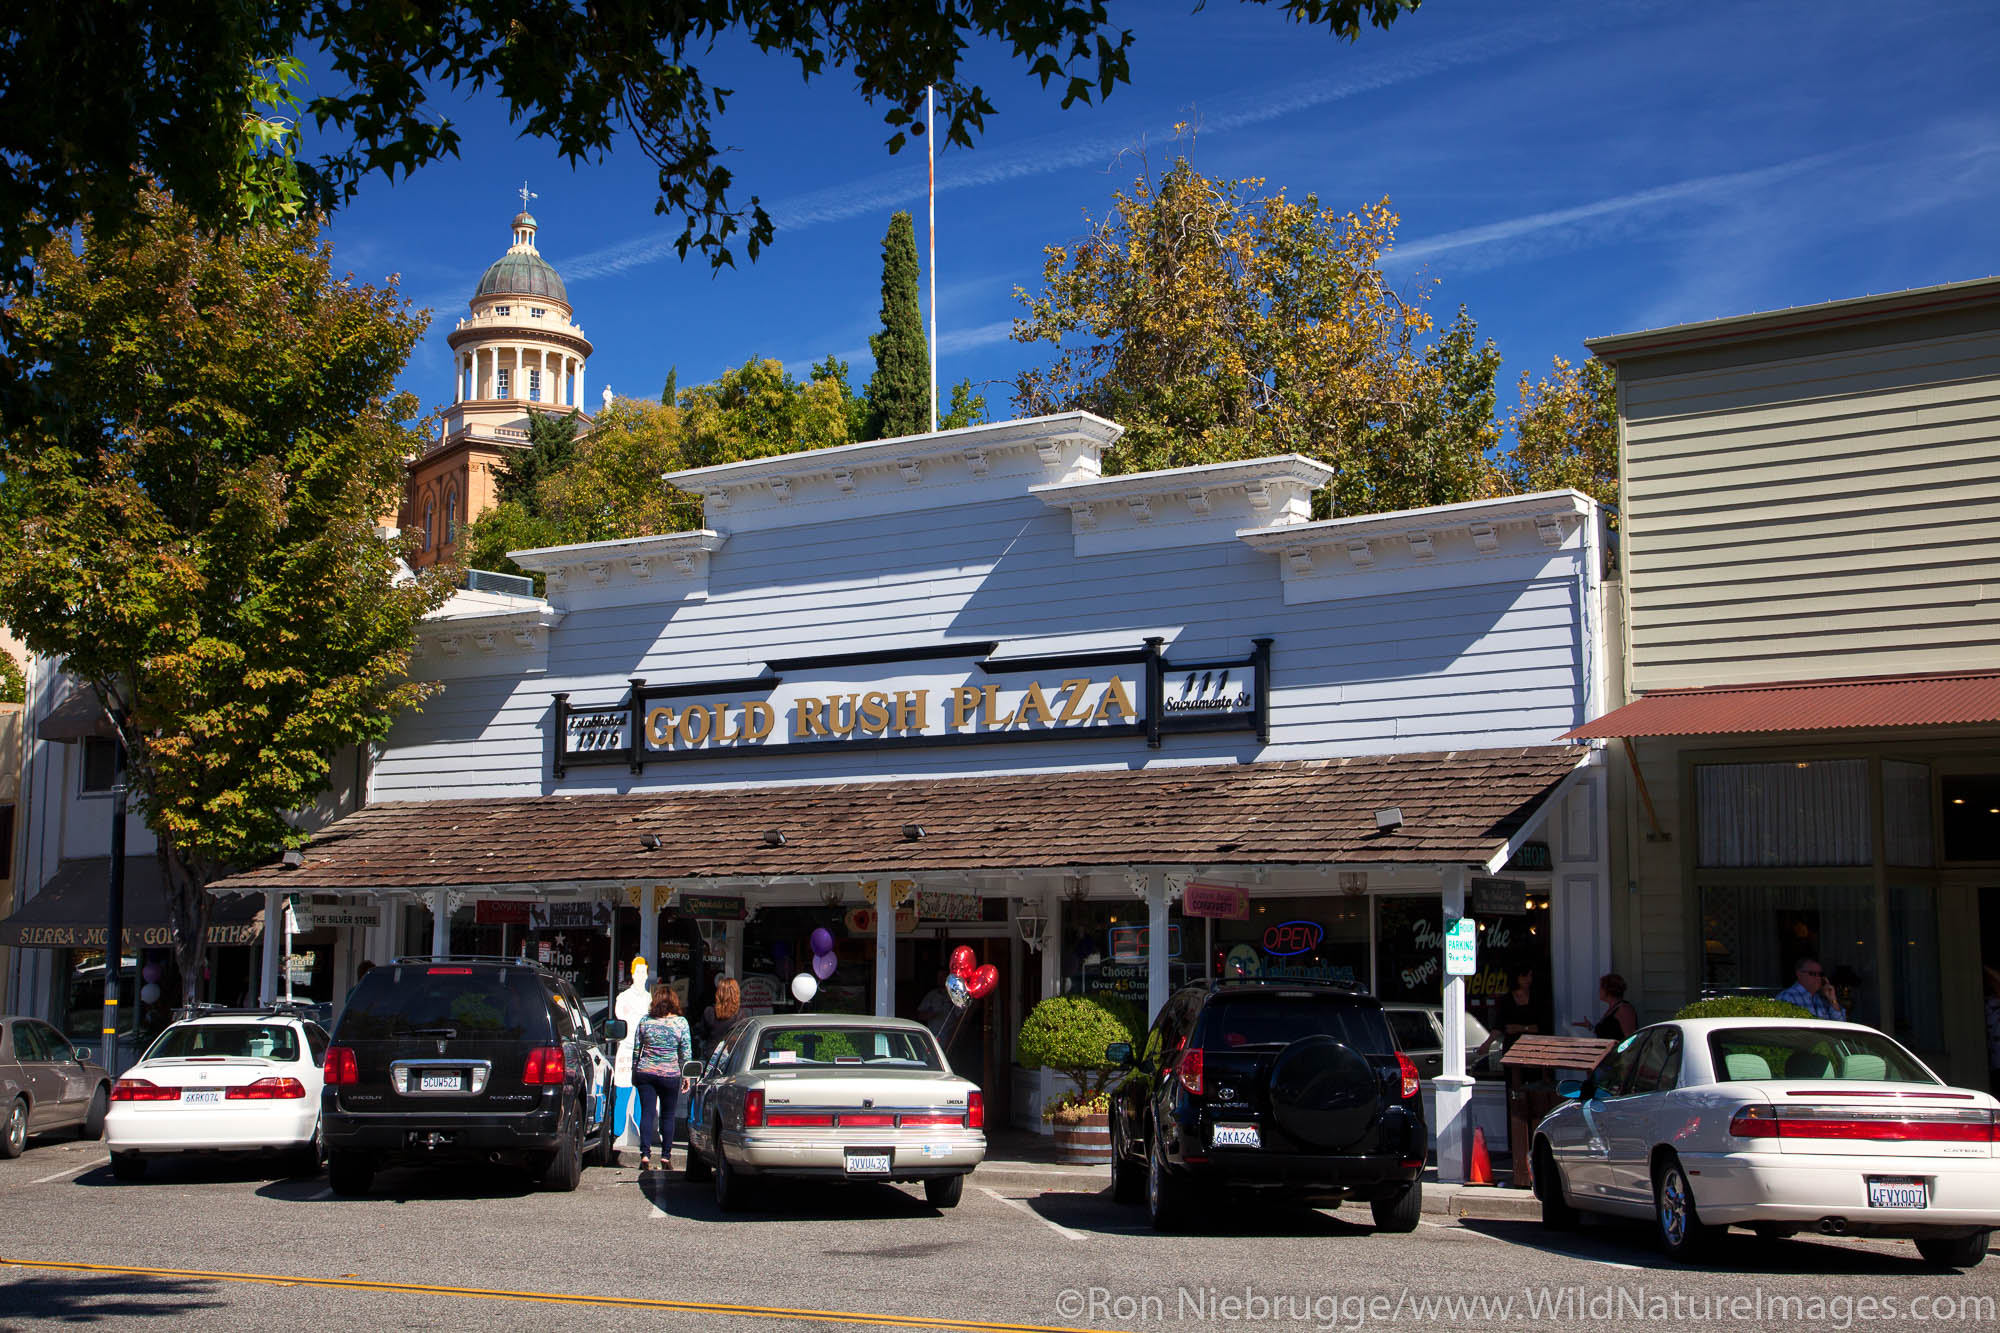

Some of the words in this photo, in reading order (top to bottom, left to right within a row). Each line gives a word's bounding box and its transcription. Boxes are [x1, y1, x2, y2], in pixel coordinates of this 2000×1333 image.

[1185, 670, 1229, 693] 111
[645, 700, 775, 746] GOLD
[793, 688, 930, 737] RUSH
[949, 673, 1138, 728] PLAZA
[1165, 695, 1232, 712] Sacramento
[570, 712, 627, 729] Established
[578, 729, 619, 748] 1906
[313, 915, 326, 924] THE
[328, 915, 352, 924] SILVER
[355, 916, 377, 925] STORE
[20, 926, 75, 945] SIERRA
[83, 926, 130, 945] MON
[1264, 927, 1318, 951] OPEN
[1487, 918, 1512, 950] the
[1448, 940, 1474, 951] PARKING
[550, 950, 574, 966] The
[1102, 966, 1136, 977] Choose
[1401, 956, 1438, 991] Super
[1091, 981, 1115, 990] Over
[424, 1077, 458, 1088] 5CUW521
[1216, 1131, 1258, 1145] 6AKA264
[850, 1157, 887, 1169] 3VVU432
[1873, 1189, 1922, 1204] 4FVY007
